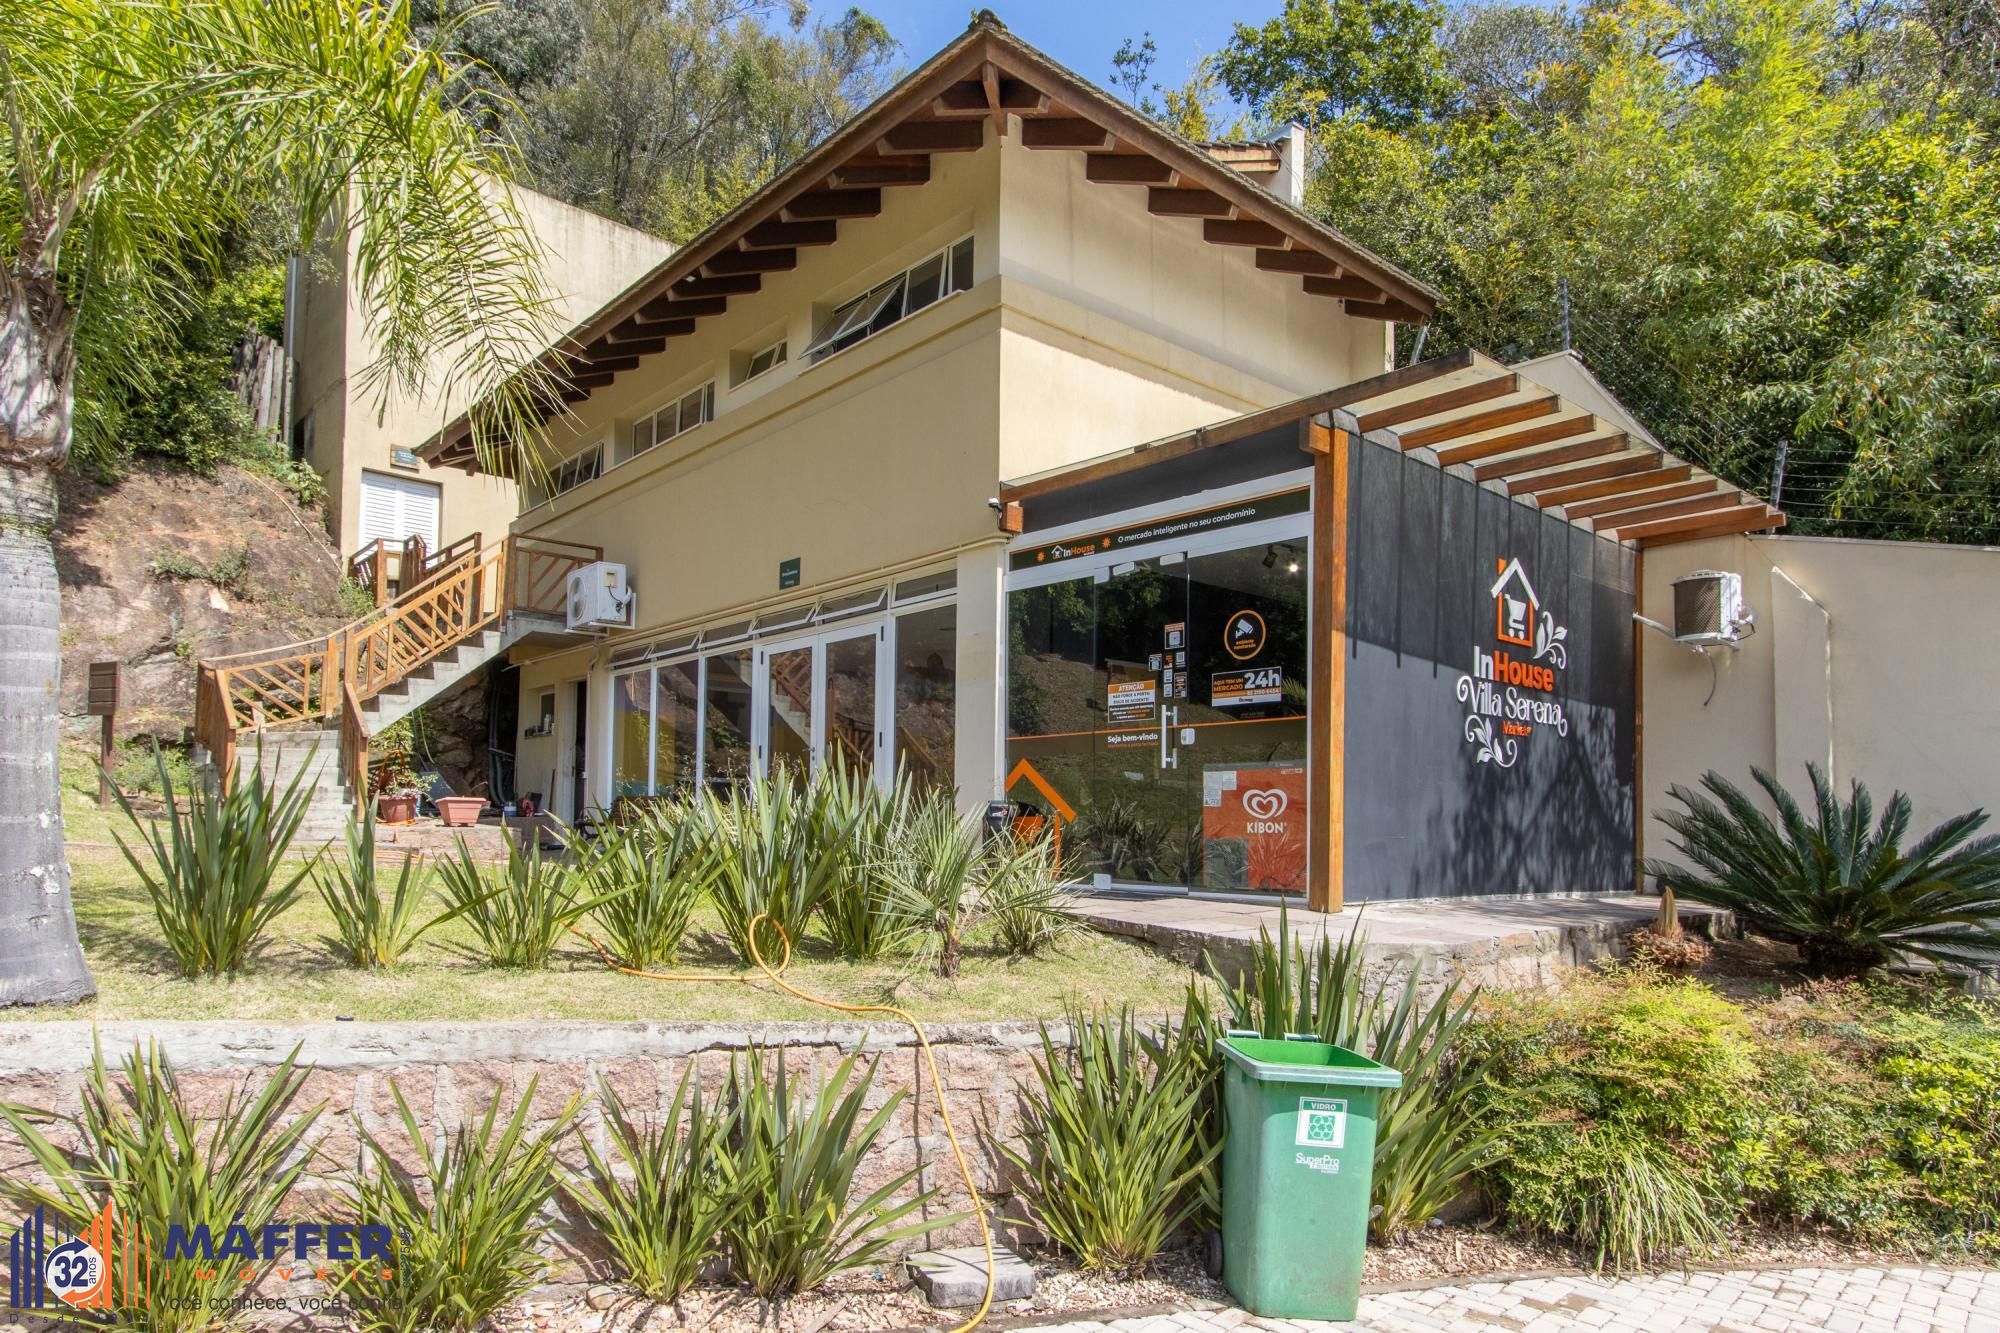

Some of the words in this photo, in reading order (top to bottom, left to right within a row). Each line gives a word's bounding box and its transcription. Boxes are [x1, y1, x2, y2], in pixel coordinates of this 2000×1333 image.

[1124, 530, 1152, 542] mercado
[1153, 523, 1188, 536] inteligente
[1200, 518, 1212, 526] seu
[1212, 508, 1256, 523] condomínio
[1064, 544, 1095, 557] InHouse
[1474, 645, 1554, 692] InHouse
[1244, 670, 1280, 690] 24h
[1118, 682, 1144, 692] ATENÇÃO
[1214, 684, 1243, 692] MERCADO
[1457, 676, 1502, 717] Villa
[1505, 686, 1568, 737] Serena
[1108, 735, 1121, 744] Seja
[1122, 732, 1158, 742] bem-vindo
[1247, 822, 1284, 834] KIBON
[1296, 1152, 1340, 1166] SuperPro
